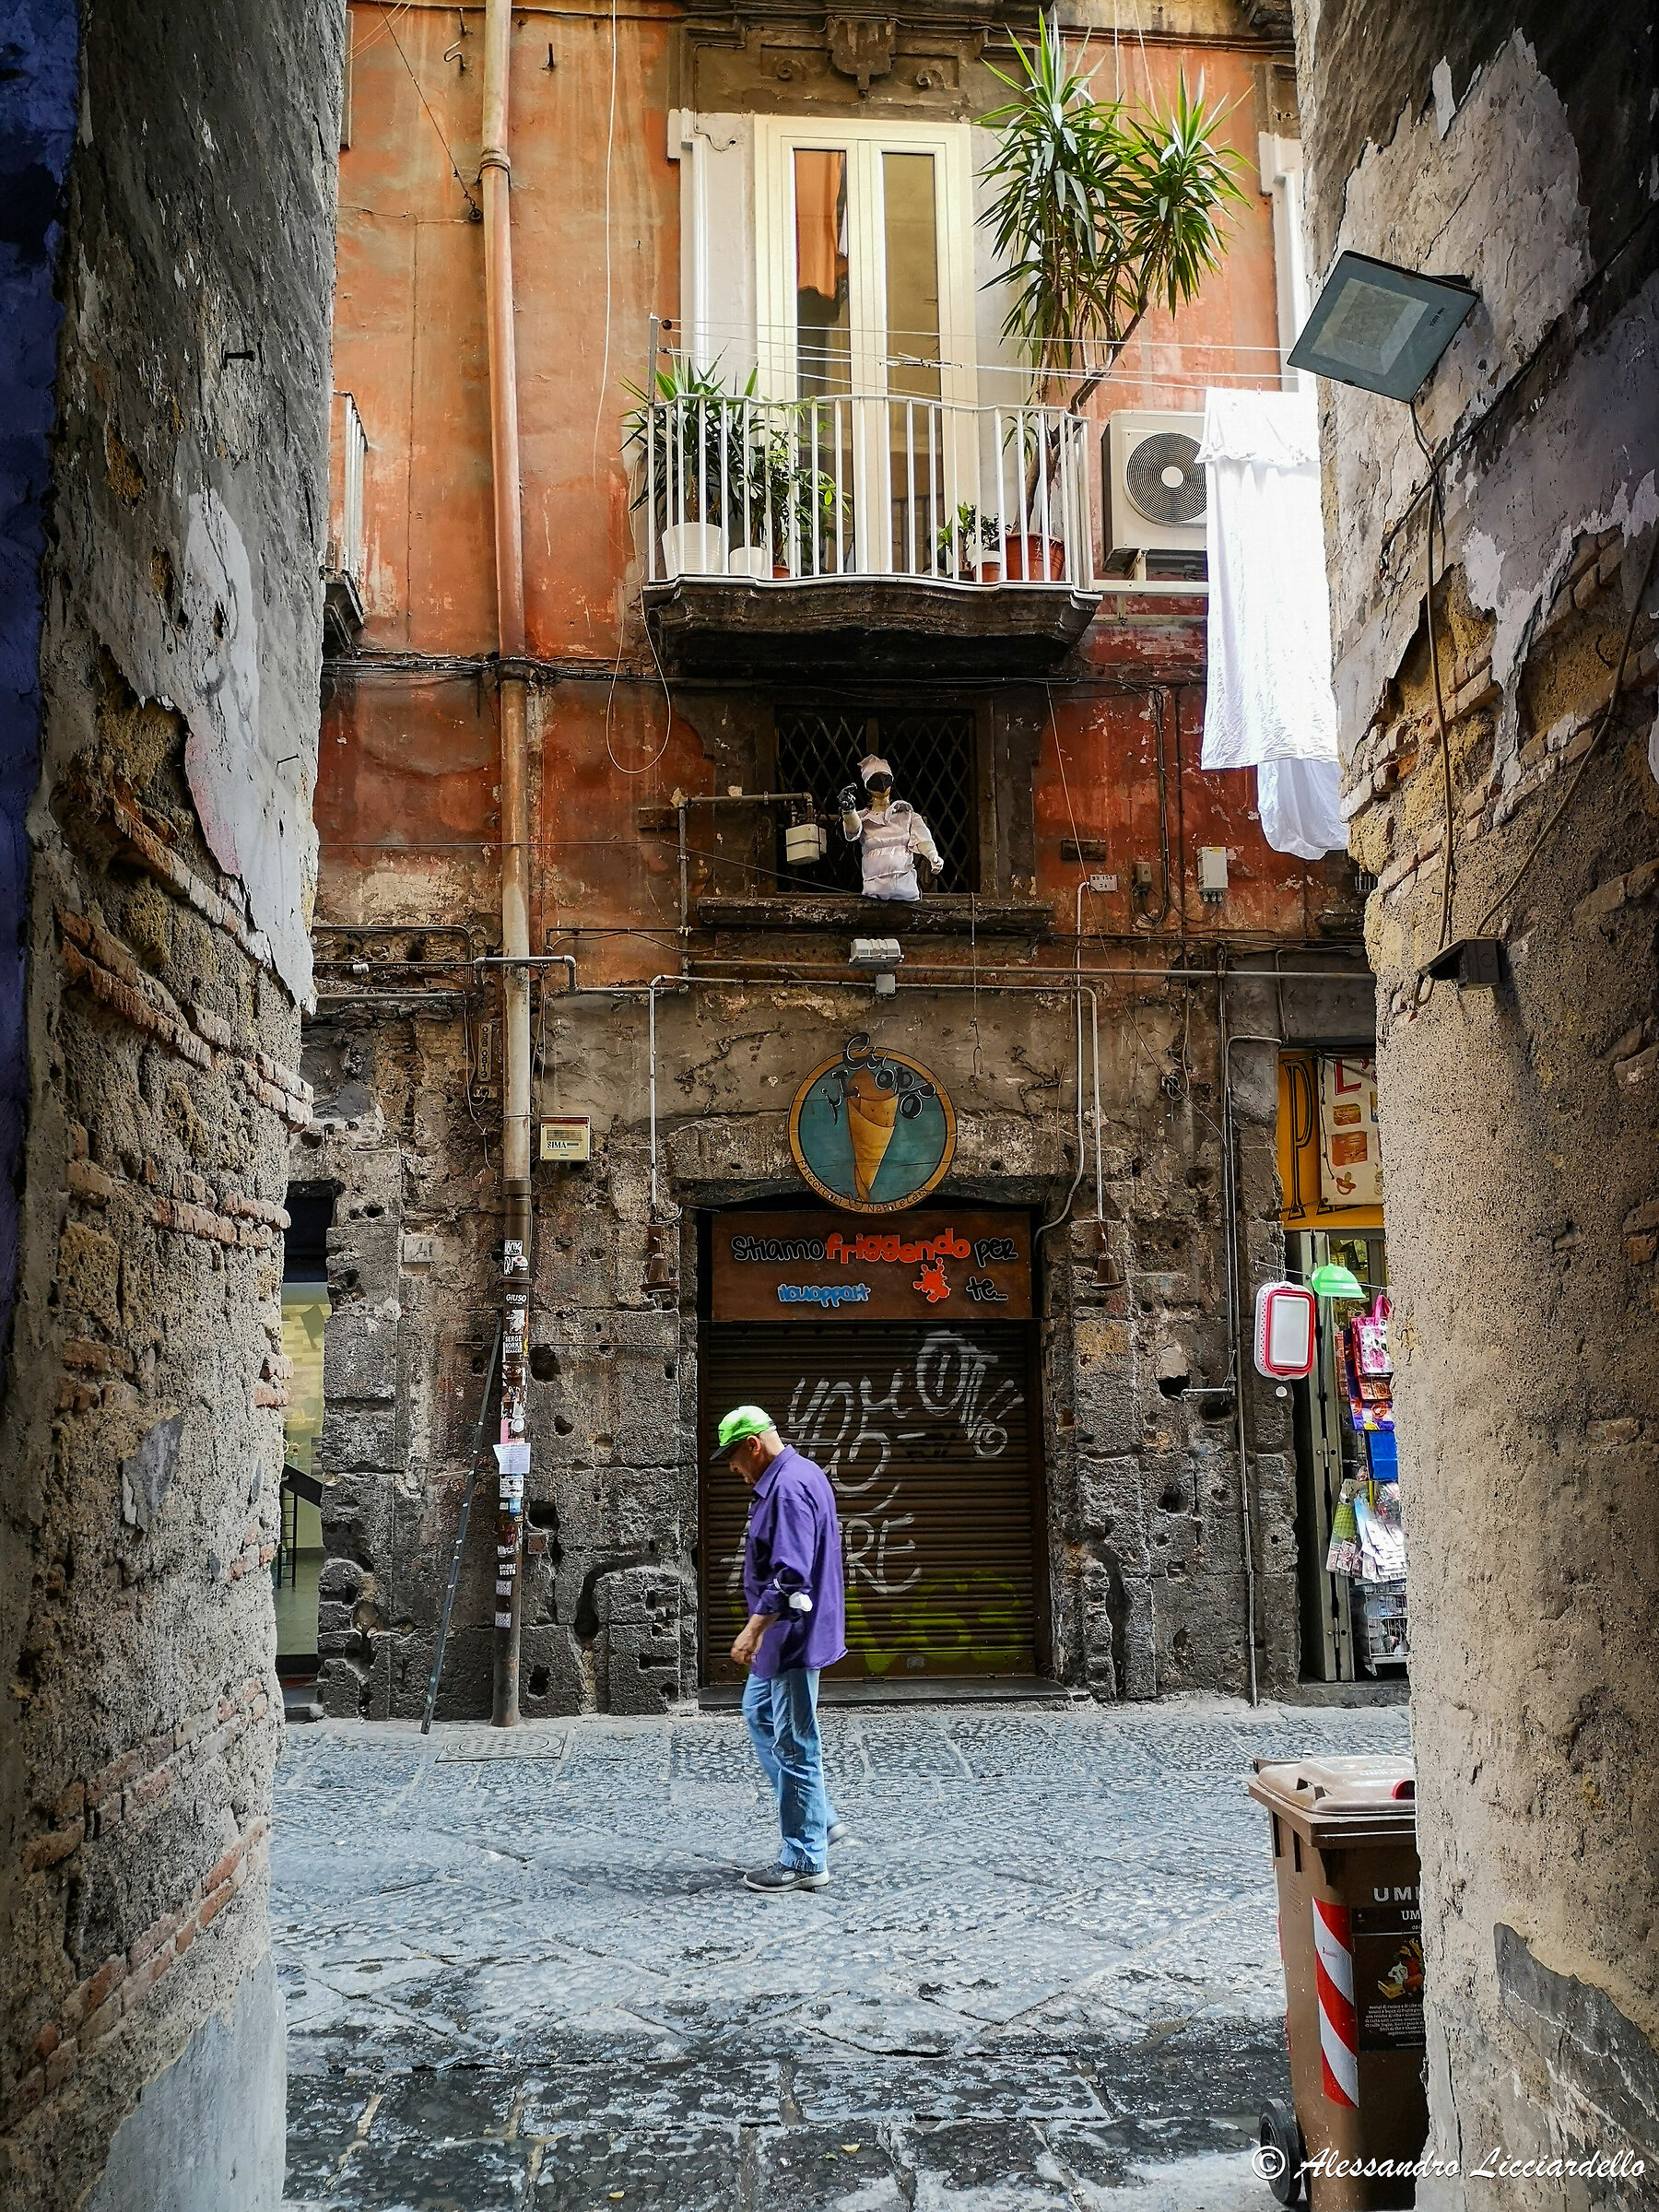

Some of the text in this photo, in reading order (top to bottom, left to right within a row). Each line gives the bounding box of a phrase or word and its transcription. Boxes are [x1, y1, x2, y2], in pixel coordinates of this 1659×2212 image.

[547, 1141, 567, 1149] SIMA
[731, 1235, 826, 1261] Stiamo
[825, 1228, 971, 1264] friggendo
[506, 1293, 526, 1301] GIUSO
